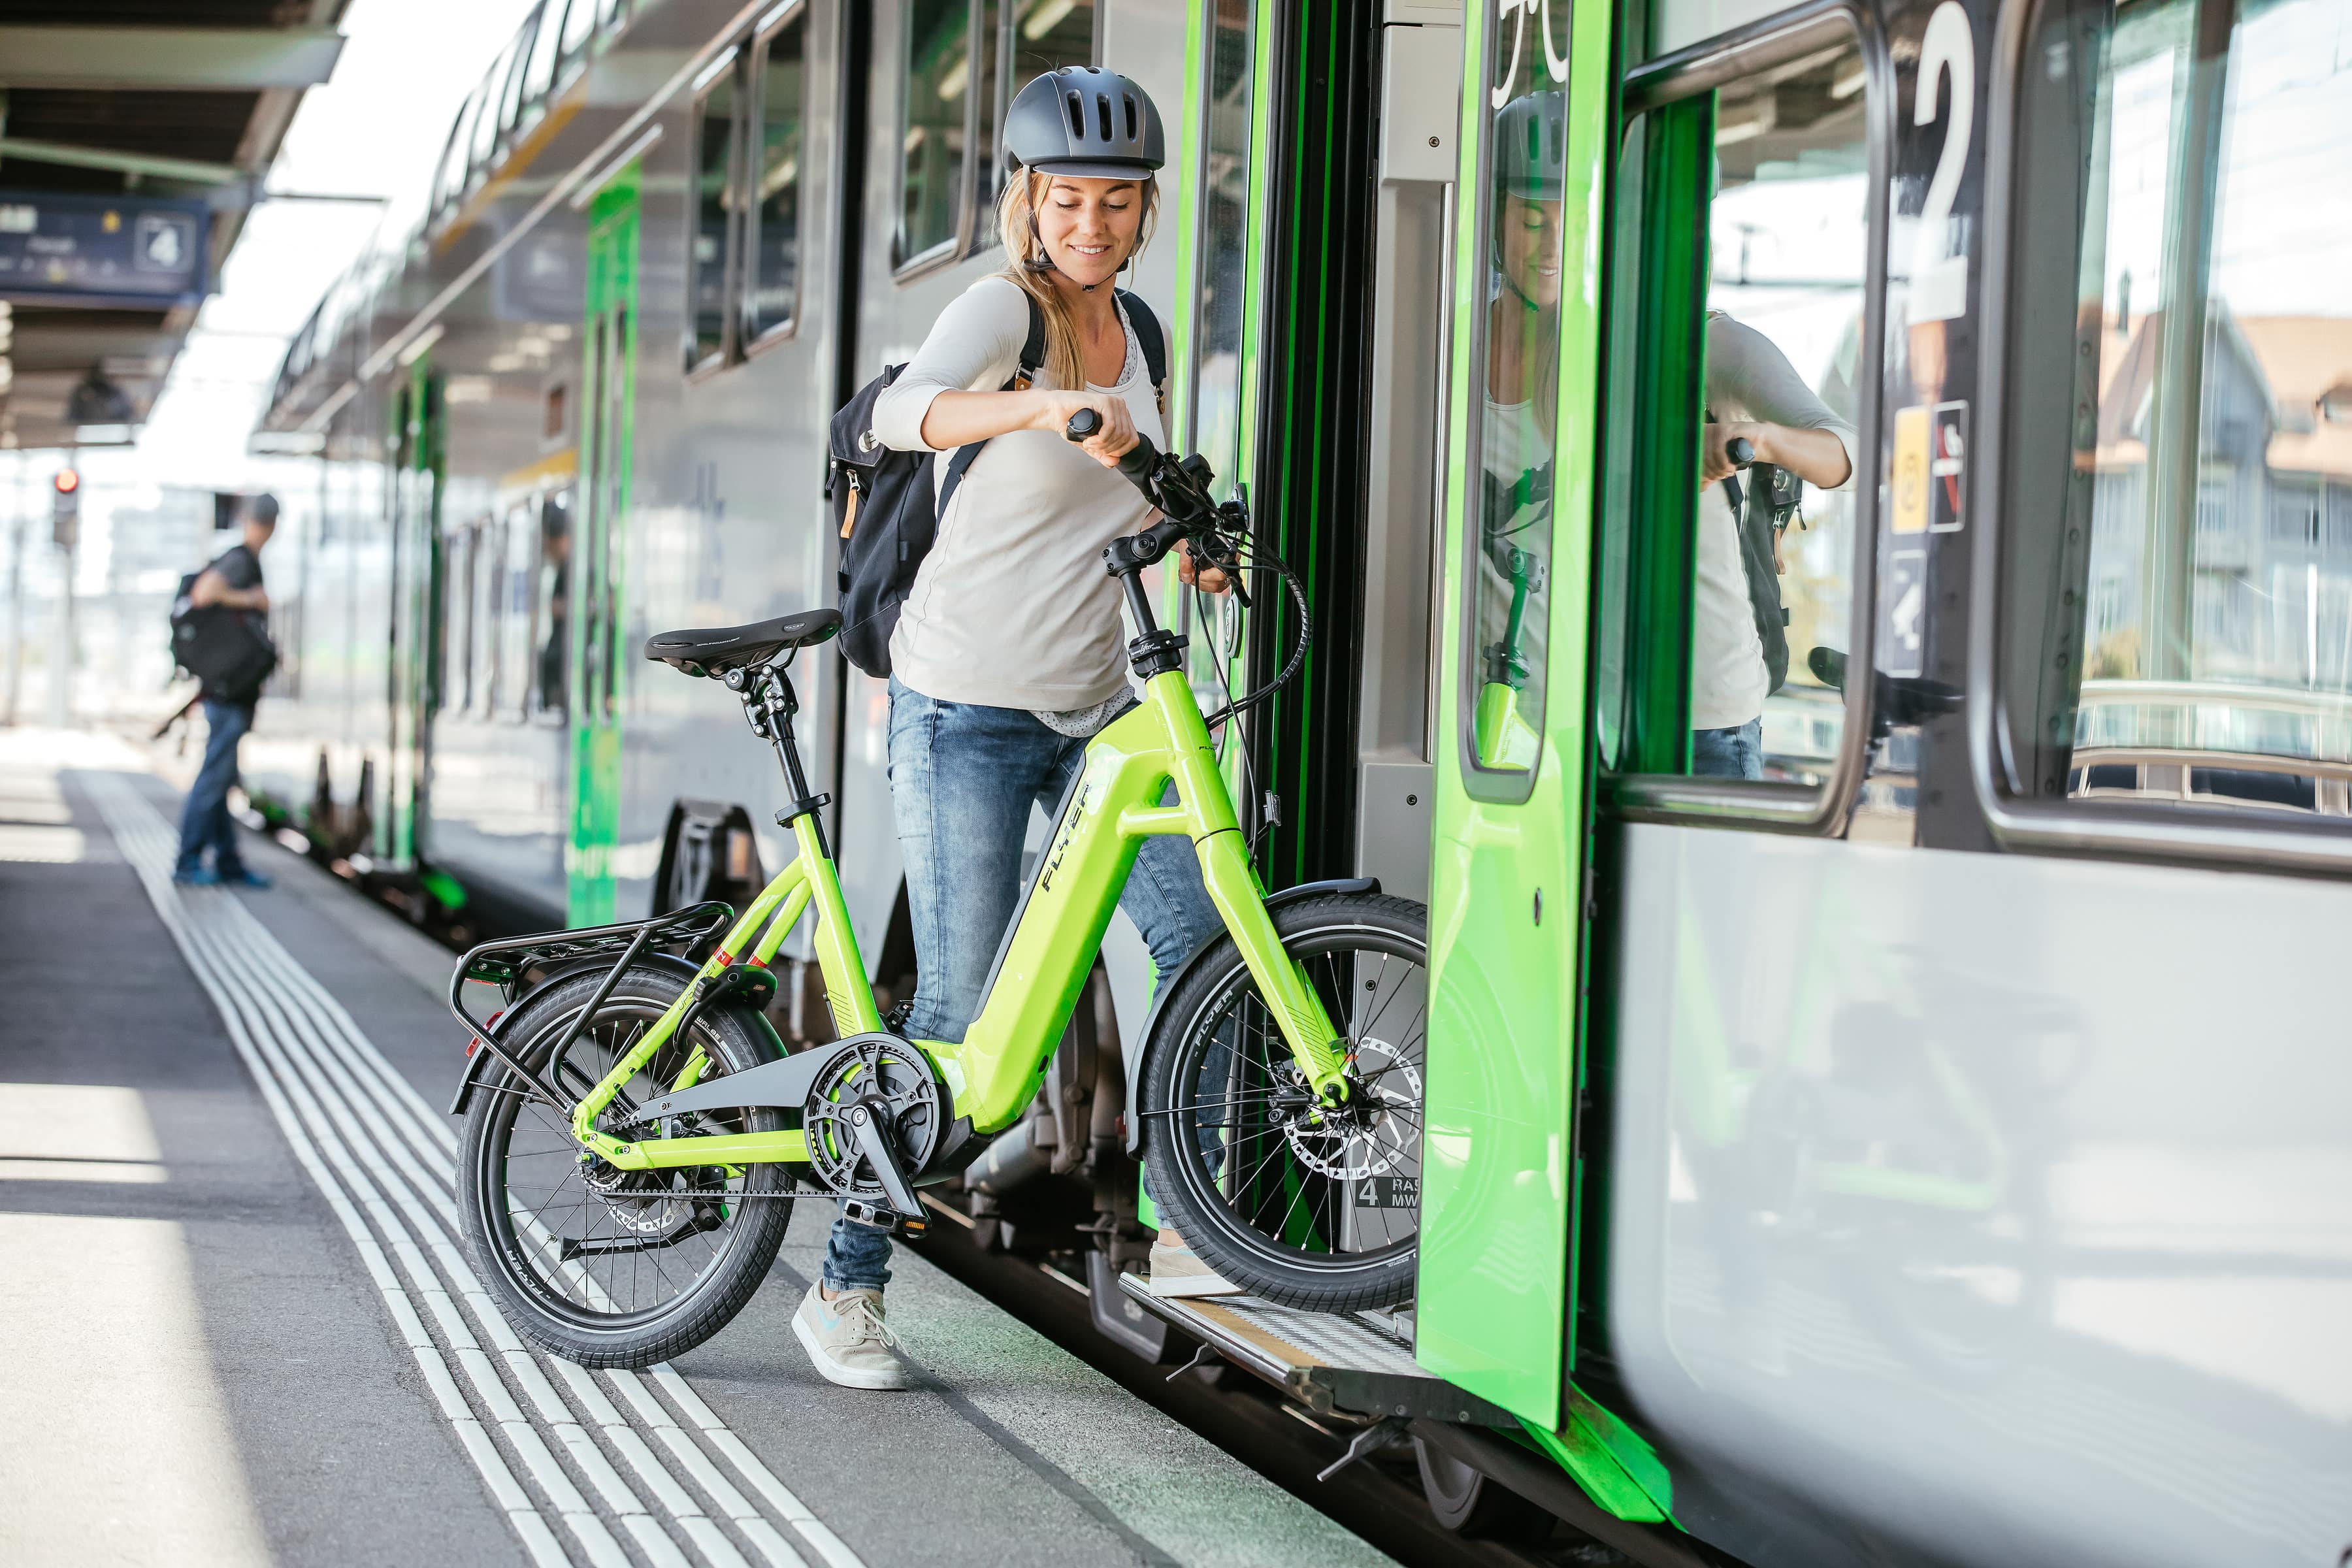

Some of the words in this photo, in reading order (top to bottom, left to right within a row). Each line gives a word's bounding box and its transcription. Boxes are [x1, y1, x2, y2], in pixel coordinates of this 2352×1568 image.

[1906, 1, 1974, 325] 2
[149, 225, 180, 267] 4
[1041, 781, 1090, 892] FLYER
[696, 1016, 721, 1041] WALBE
[1195, 990, 1233, 1047] FLYER
[1359, 1178, 1379, 1206] 4
[507, 1250, 544, 1295] FLYER
